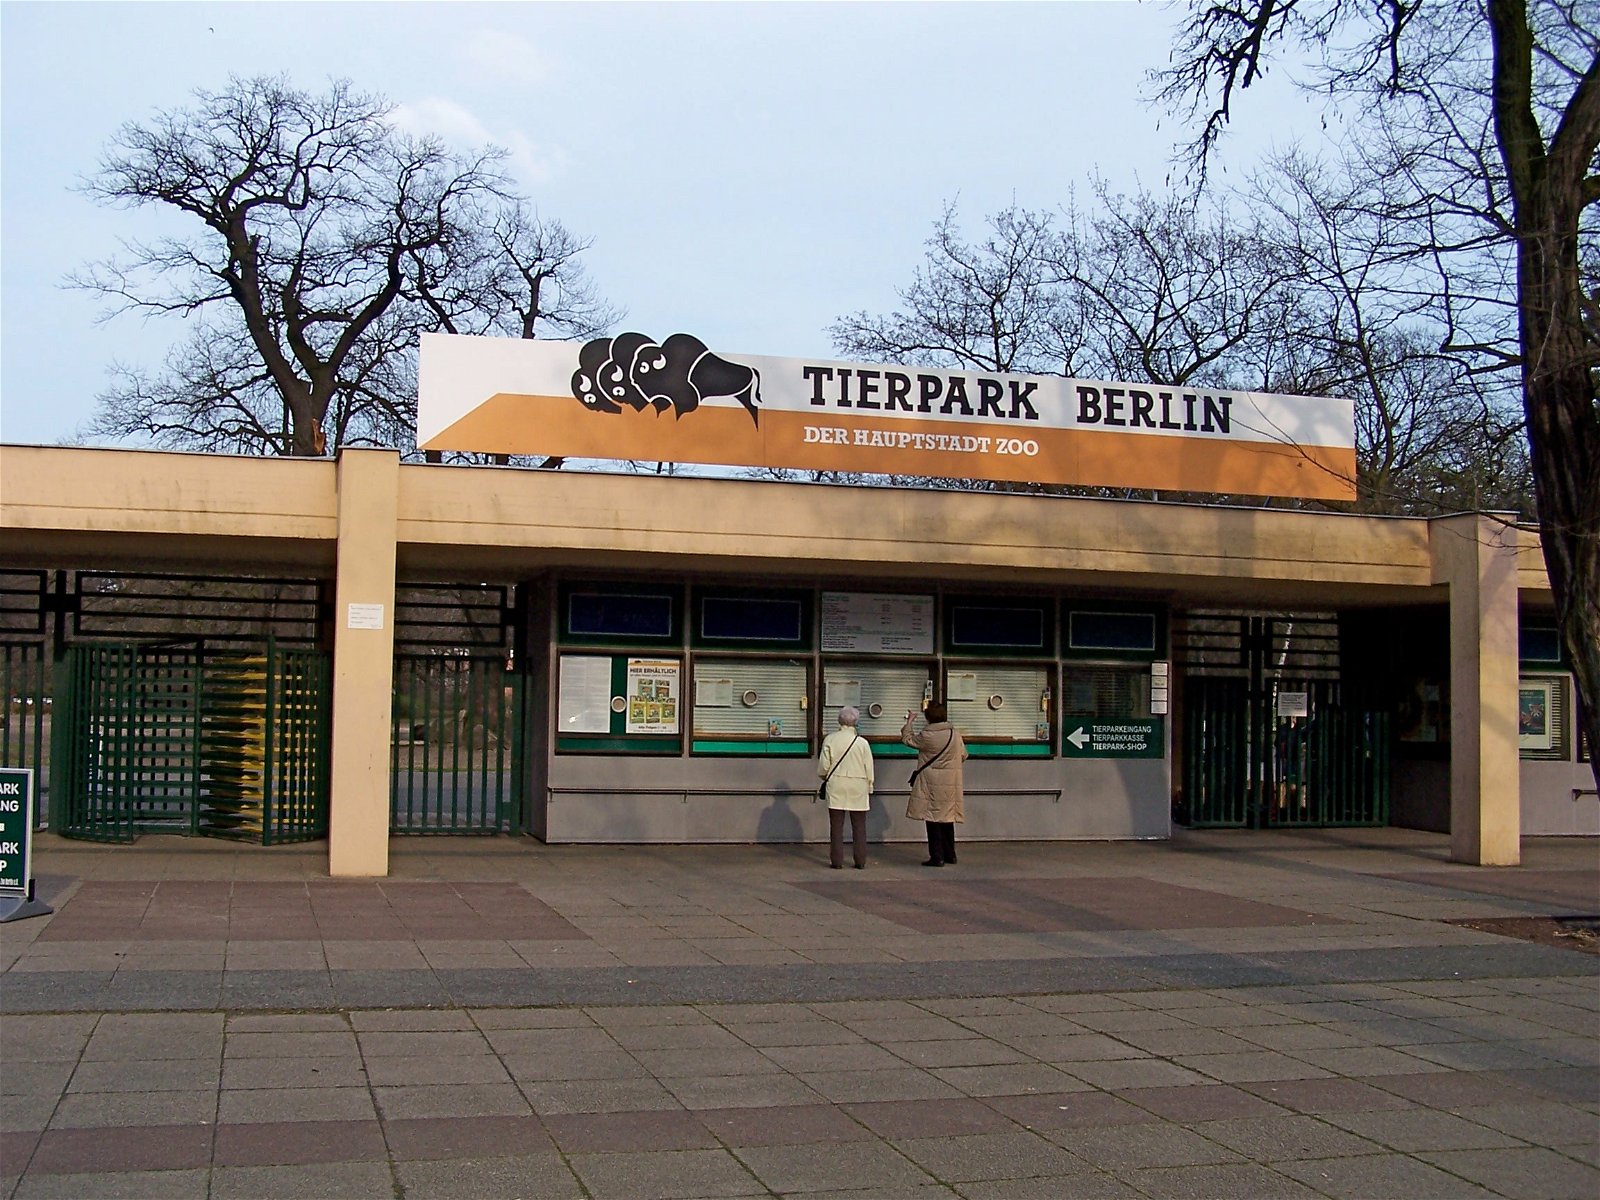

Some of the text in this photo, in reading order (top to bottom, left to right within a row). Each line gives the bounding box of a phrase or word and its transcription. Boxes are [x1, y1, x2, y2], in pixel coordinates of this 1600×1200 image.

[803, 366, 1232, 433] TIERPARK BERLIN
[803, 426, 1039, 456] DER HAUPTSTADT ZOO
[1092, 725, 1152, 733] TIERPARKEINGANG
[1092, 734, 1145, 742] TIERPARKKASSE
[0, 800, 19, 812] NG
[0, 842, 19, 855] RK
